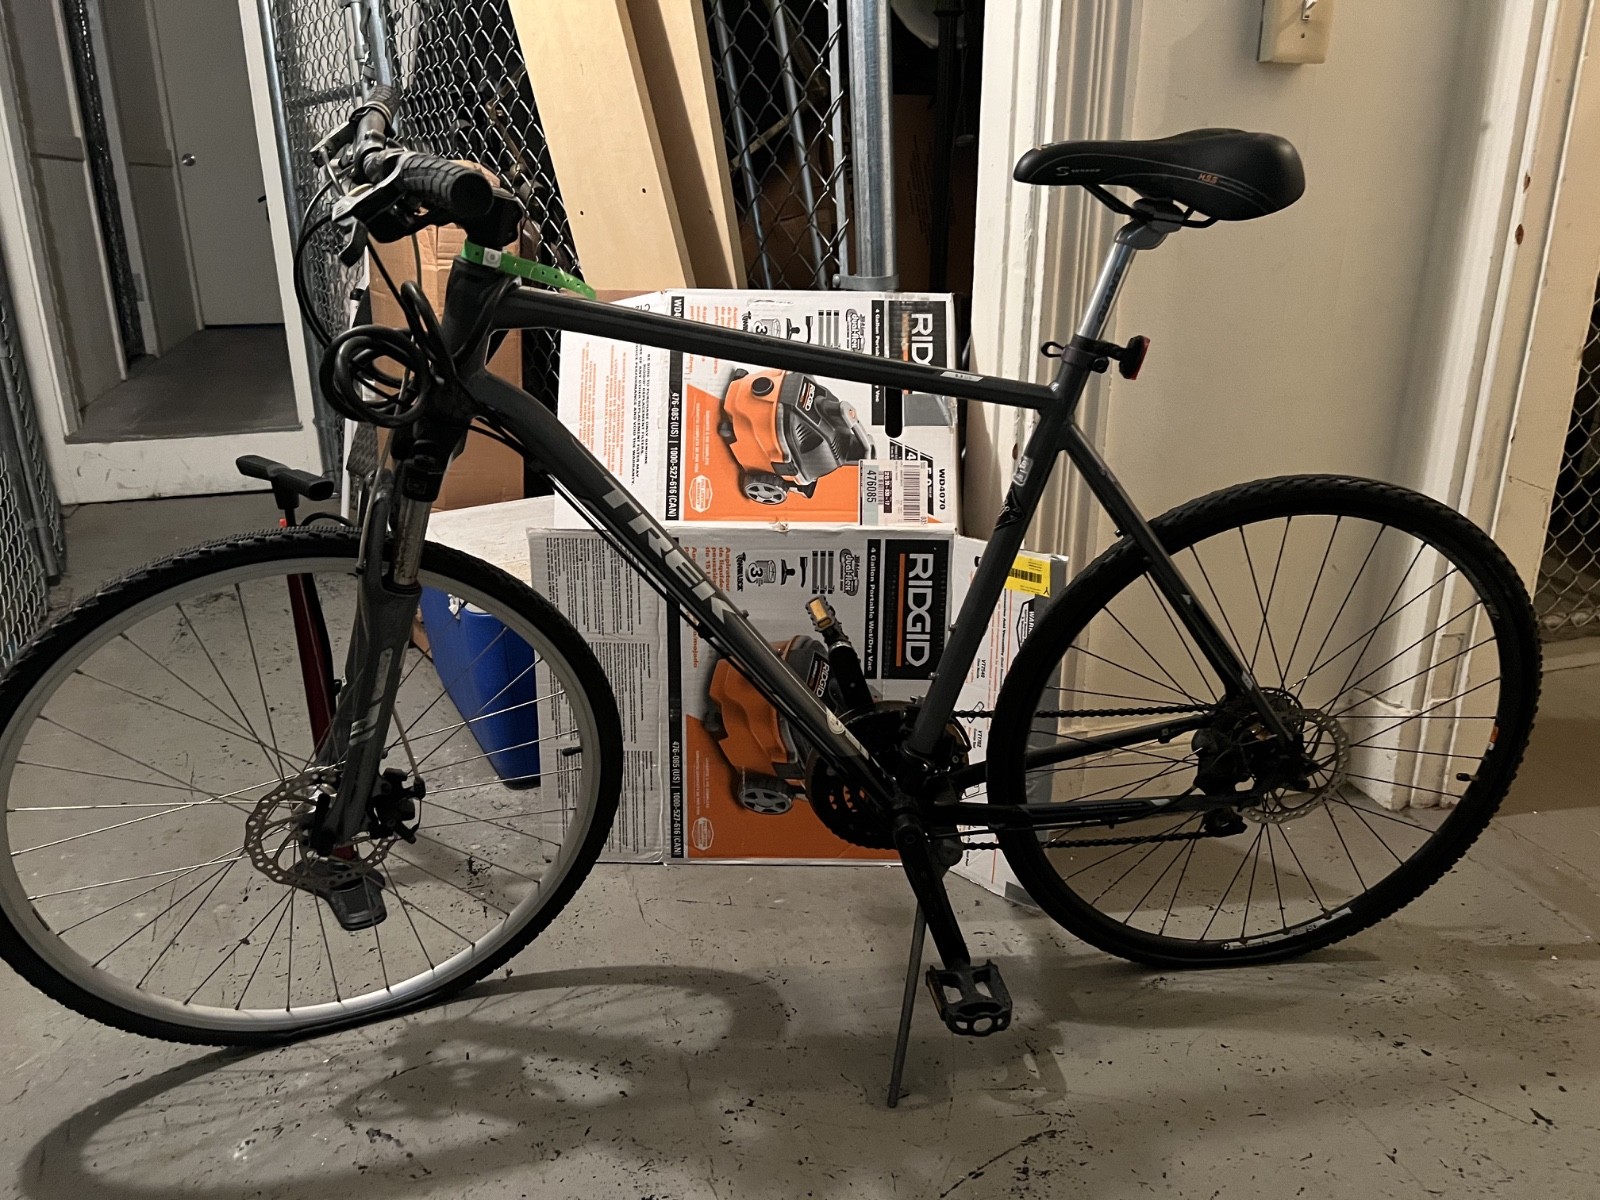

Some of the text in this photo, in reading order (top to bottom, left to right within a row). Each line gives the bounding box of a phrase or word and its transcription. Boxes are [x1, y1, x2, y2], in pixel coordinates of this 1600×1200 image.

[851, 314, 859, 349] dual-flex
[911, 313, 933, 365] RID
[668, 299, 682, 517] WD4 476-085 (US) 1000-527-616 (CAN)
[866, 470, 877, 503] 476085
[602, 475, 736, 624] TREK
[705, 547, 711, 569] de 15
[719, 547, 724, 558] de
[751, 567, 763, 578] 3
[845, 554, 853, 590] dual-flex
[868, 584, 876, 619] Portable
[905, 553, 934, 667] RIDGID
[867, 620, 875, 654] Wet/Dry
[816, 662, 830, 698] RIDGID
[672, 740, 682, 855] 476-085 (US) 1000-527-616 (CAN)
